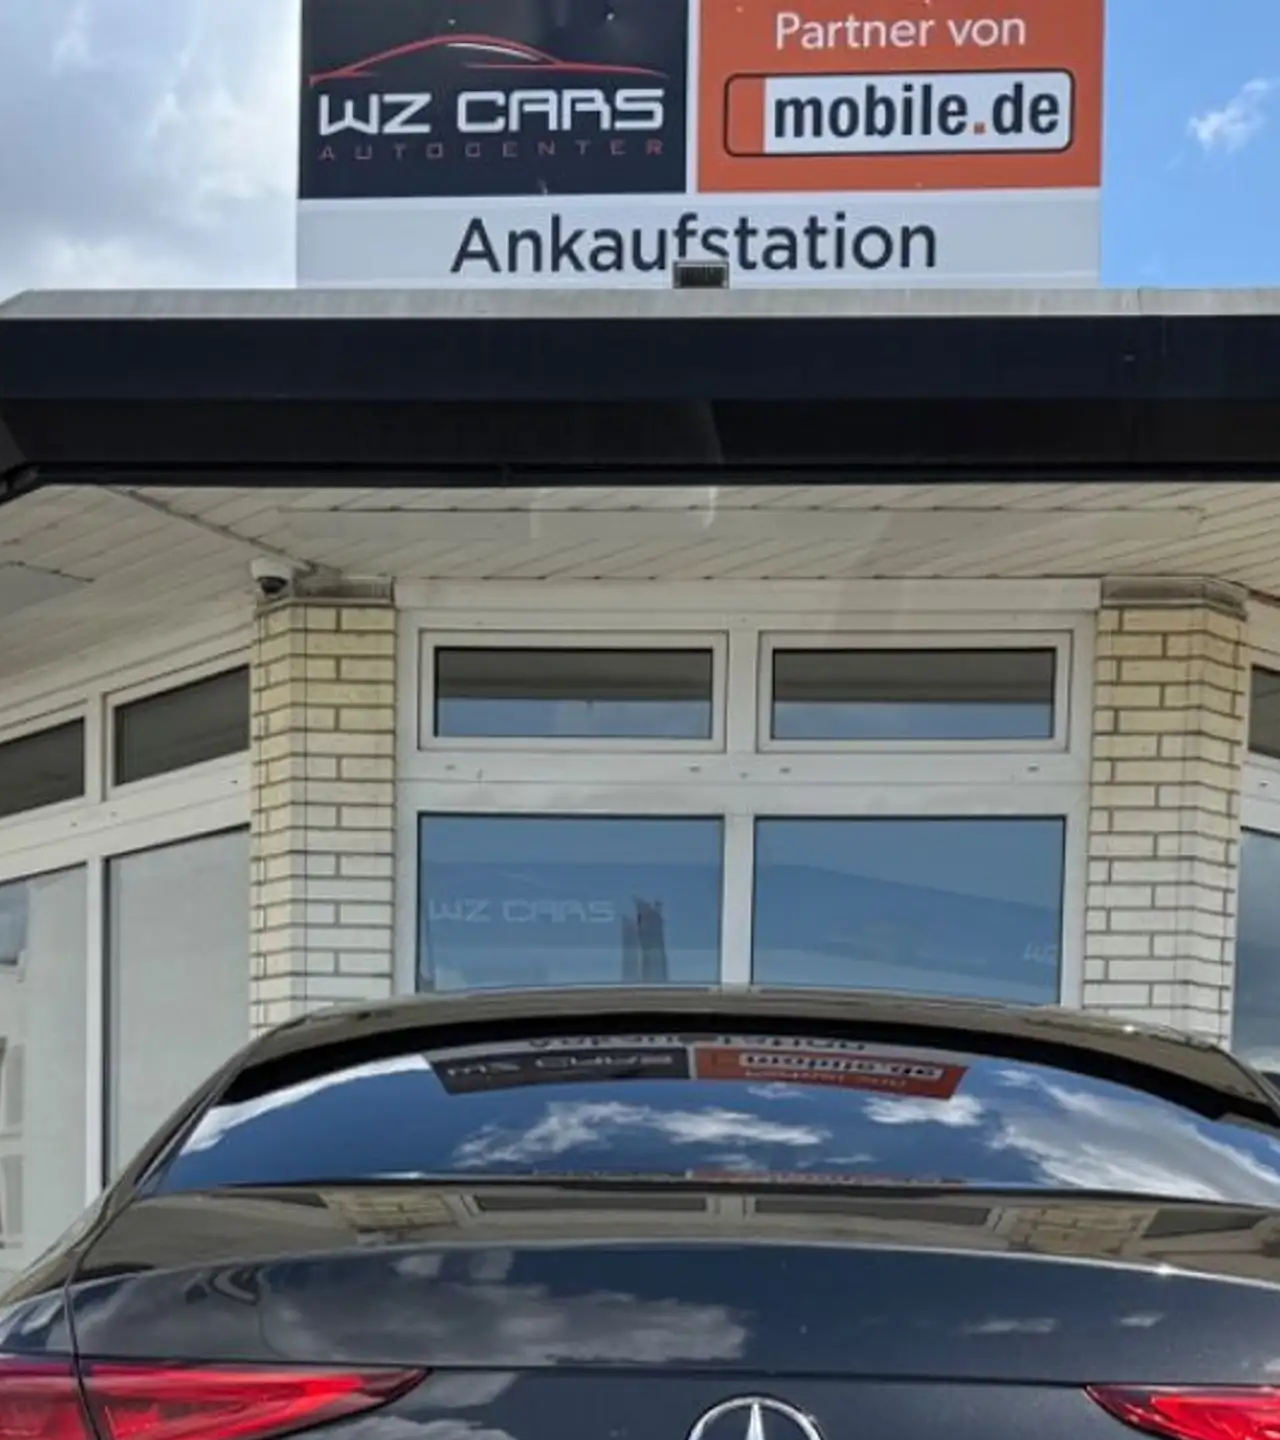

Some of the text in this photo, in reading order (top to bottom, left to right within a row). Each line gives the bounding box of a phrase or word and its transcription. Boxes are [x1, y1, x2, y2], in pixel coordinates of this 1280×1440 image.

[774, 11, 1027, 51] Partner von
[320, 88, 664, 136] WZ CARS
[772, 82, 1061, 139] mobile.de
[320, 139, 664, 161] AUTOCENTER
[449, 213, 938, 275] Ankaufstation
